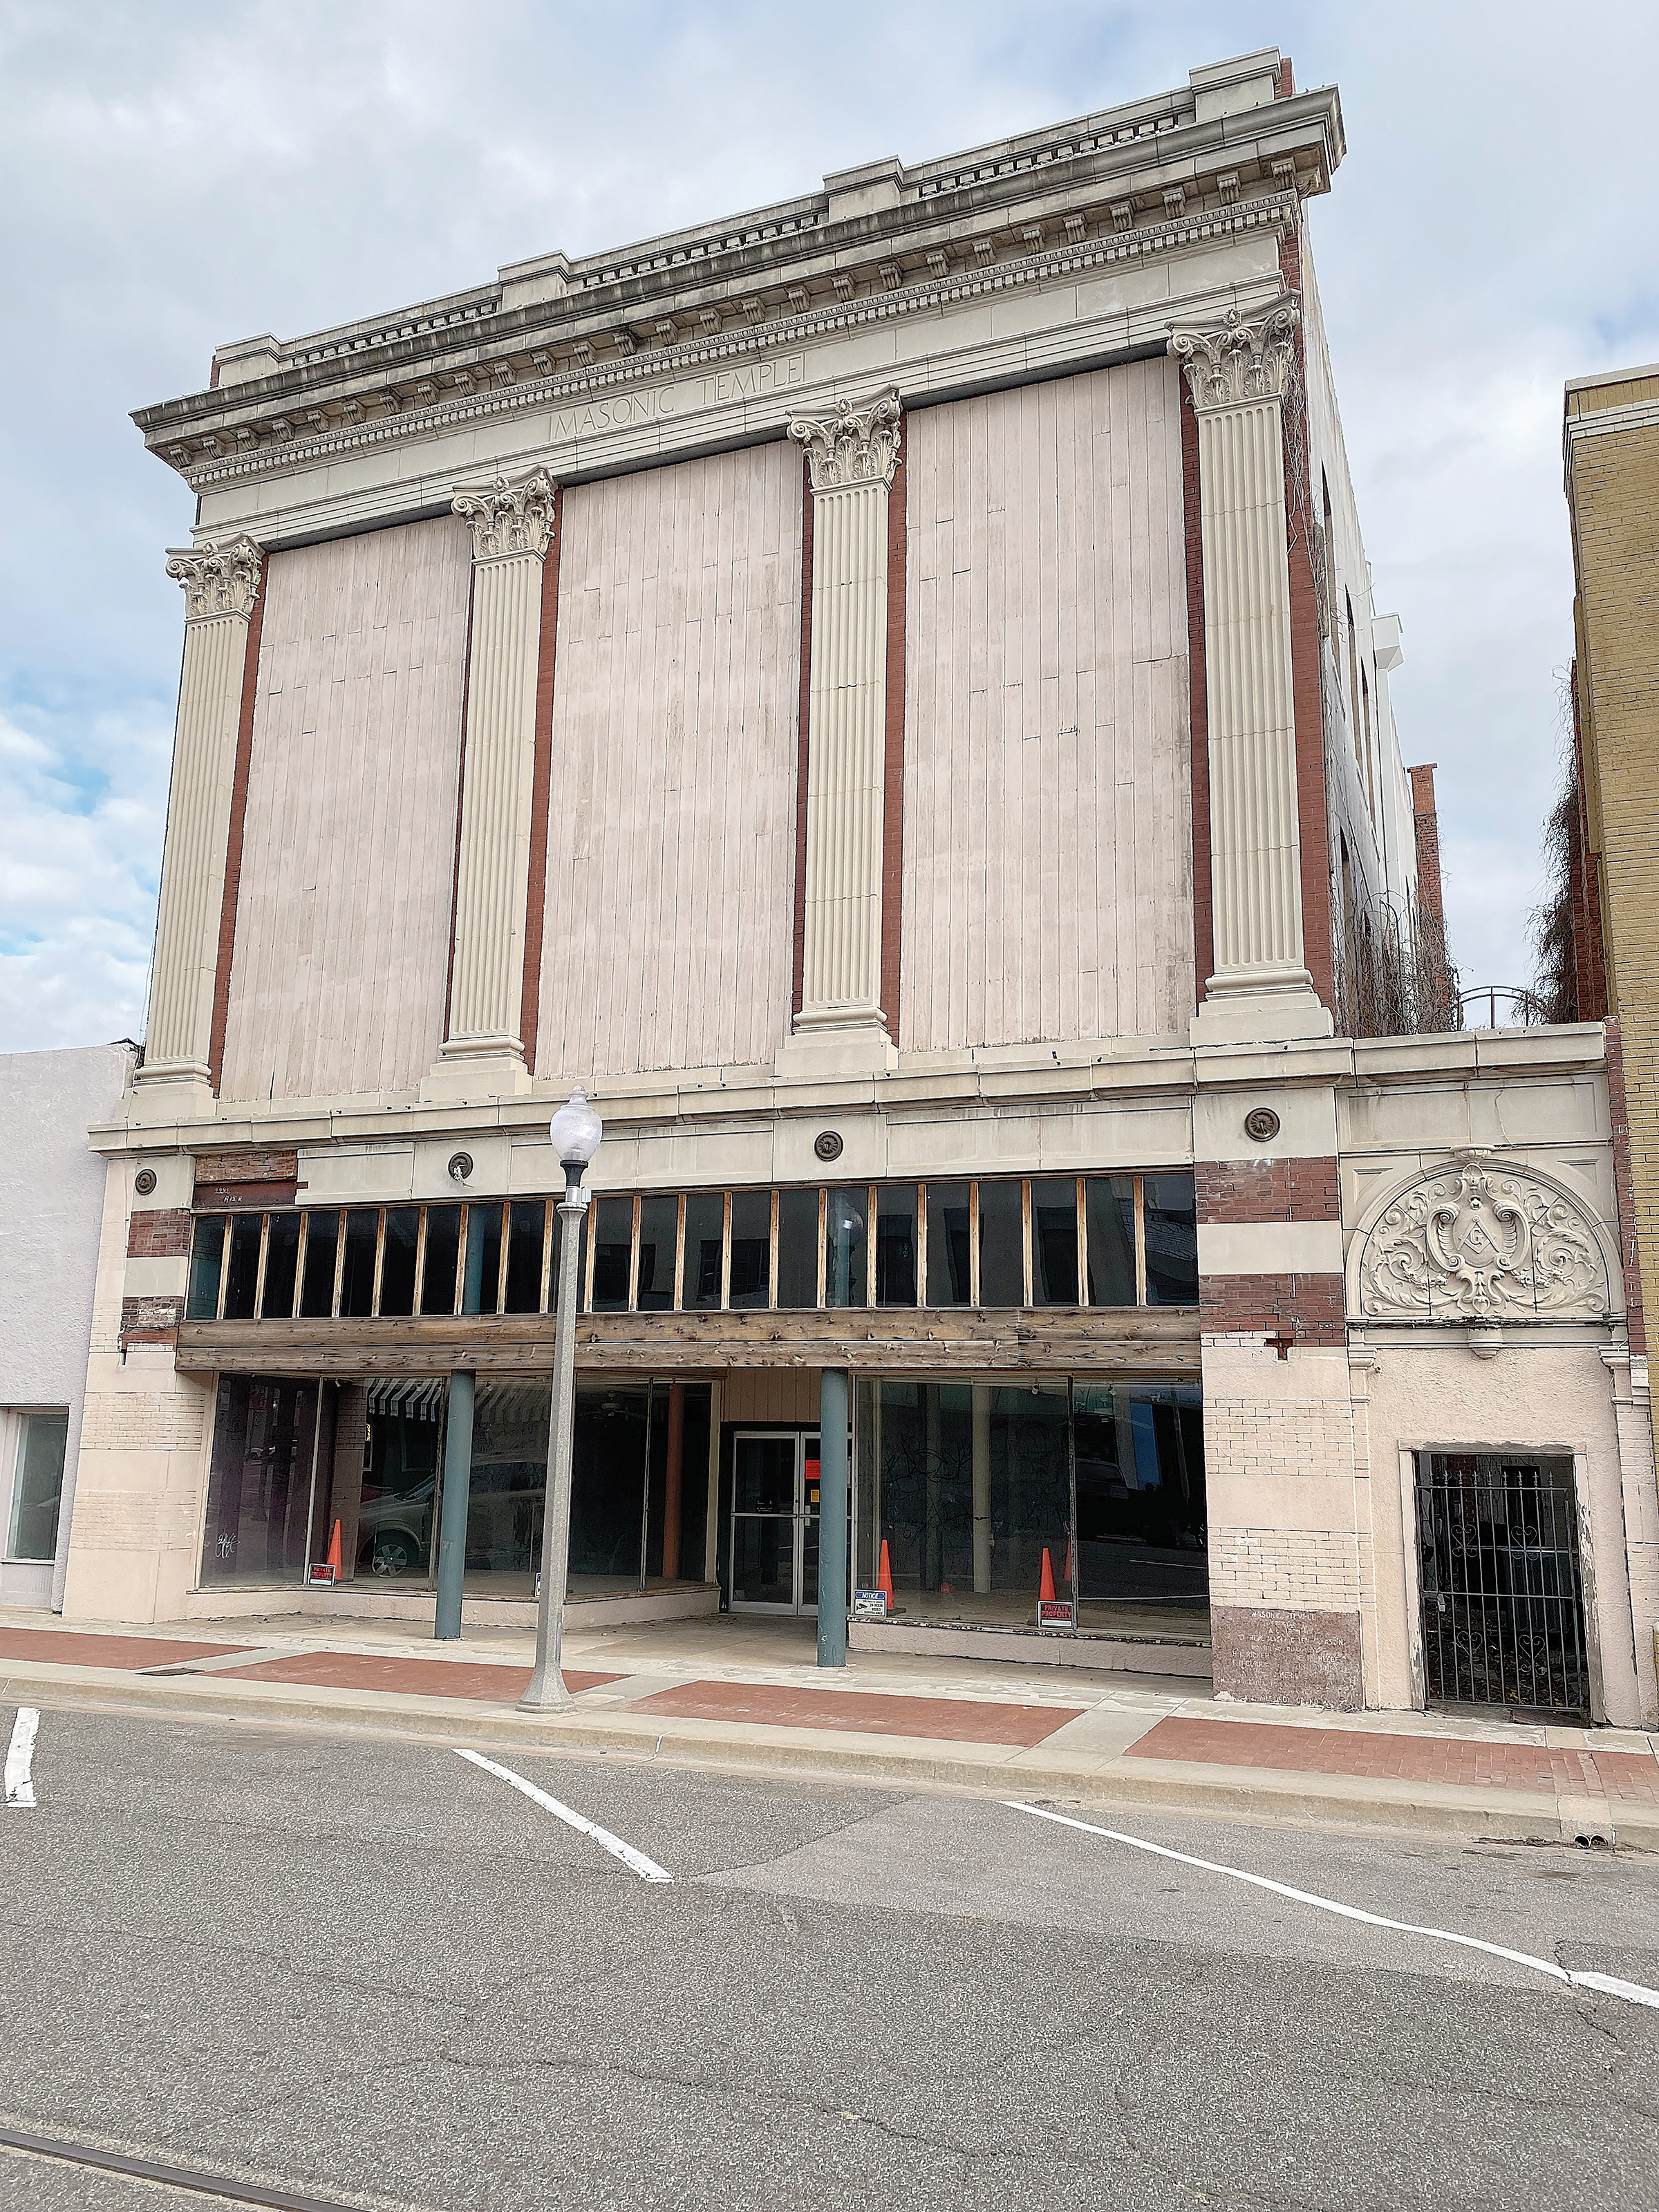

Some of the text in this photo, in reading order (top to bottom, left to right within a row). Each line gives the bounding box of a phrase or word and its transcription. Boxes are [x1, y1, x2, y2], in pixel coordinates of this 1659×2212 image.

[554, 355, 802, 439] MASONIC TEMPLE
[1041, 1610, 1071, 1618] PROPERTY
